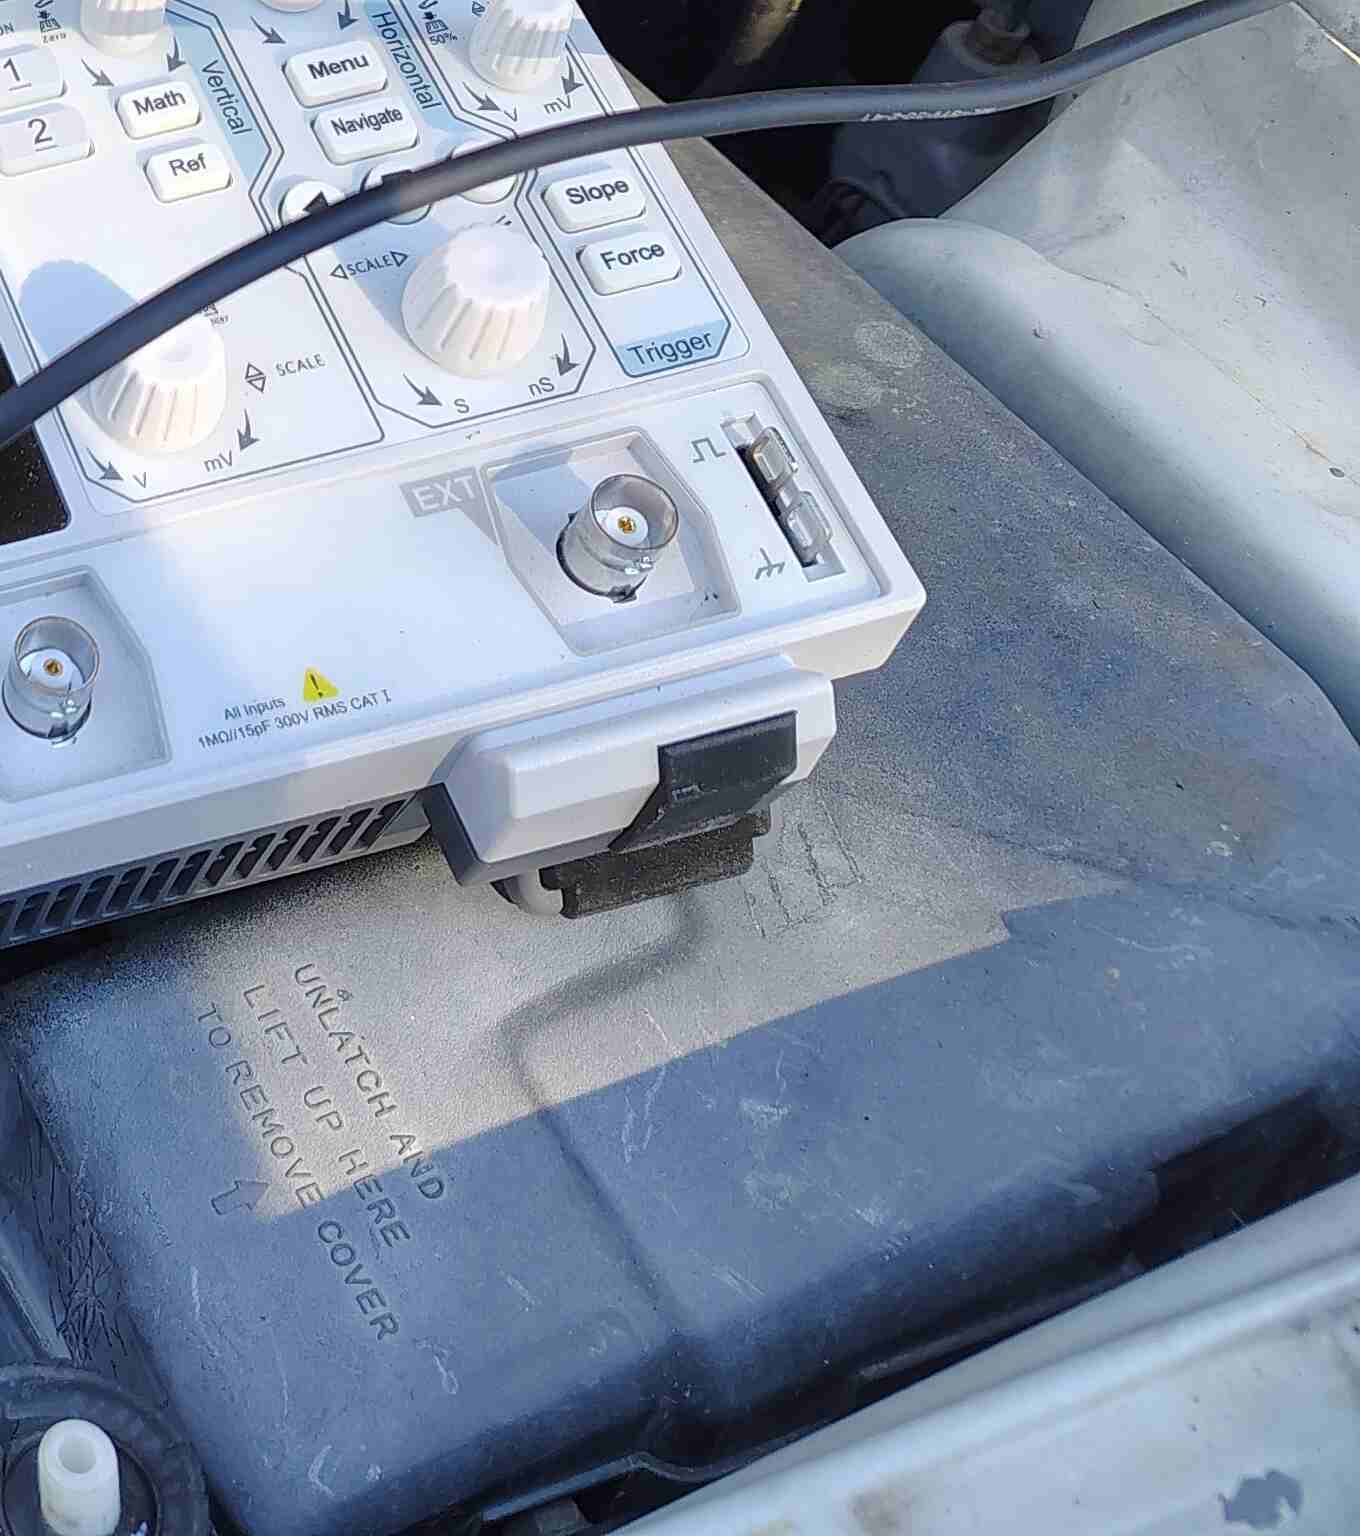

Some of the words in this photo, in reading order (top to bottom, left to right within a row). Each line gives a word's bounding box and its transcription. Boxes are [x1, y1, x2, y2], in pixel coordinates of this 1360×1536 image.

[3, 58, 22, 82] 1
[308, 52, 369, 81] Menu
[370, 11, 442, 111] Horizontal
[133, 90, 186, 116] Math
[201, 59, 253, 135] Vertical
[543, 95, 572, 115] mV
[330, 105, 404, 137] Navigate
[504, 105, 518, 122] V
[28, 119, 54, 145] 2
[169, 153, 208, 177] Ref
[565, 176, 630, 207] Slope
[347, 254, 393, 277] SCALE
[600, 242, 665, 271] Force
[627, 330, 712, 367] Trigger
[275, 353, 326, 378] SCALE
[528, 376, 555, 397] nS
[453, 397, 470, 415] S
[202, 448, 233, 473] mV
[132, 471, 148, 489] V
[411, 475, 476, 511] EXT
[224, 705, 242, 721] All
[244, 696, 286, 716] Inputs
[274, 710, 310, 730] 300V
[312, 701, 348, 721] RMS
[349, 692, 379, 711] CAT
[295, 963, 397, 1117] UNLATCH
[390, 1133, 445, 1200] AND
[242, 984, 307, 1065] LIFT
[303, 1085, 343, 1132] UP
[339, 1148, 411, 1248] HERE
[197, 1002, 232, 1048] TO
[225, 1059, 322, 1209] REMOVE
[317, 1220, 399, 1341] COVER
